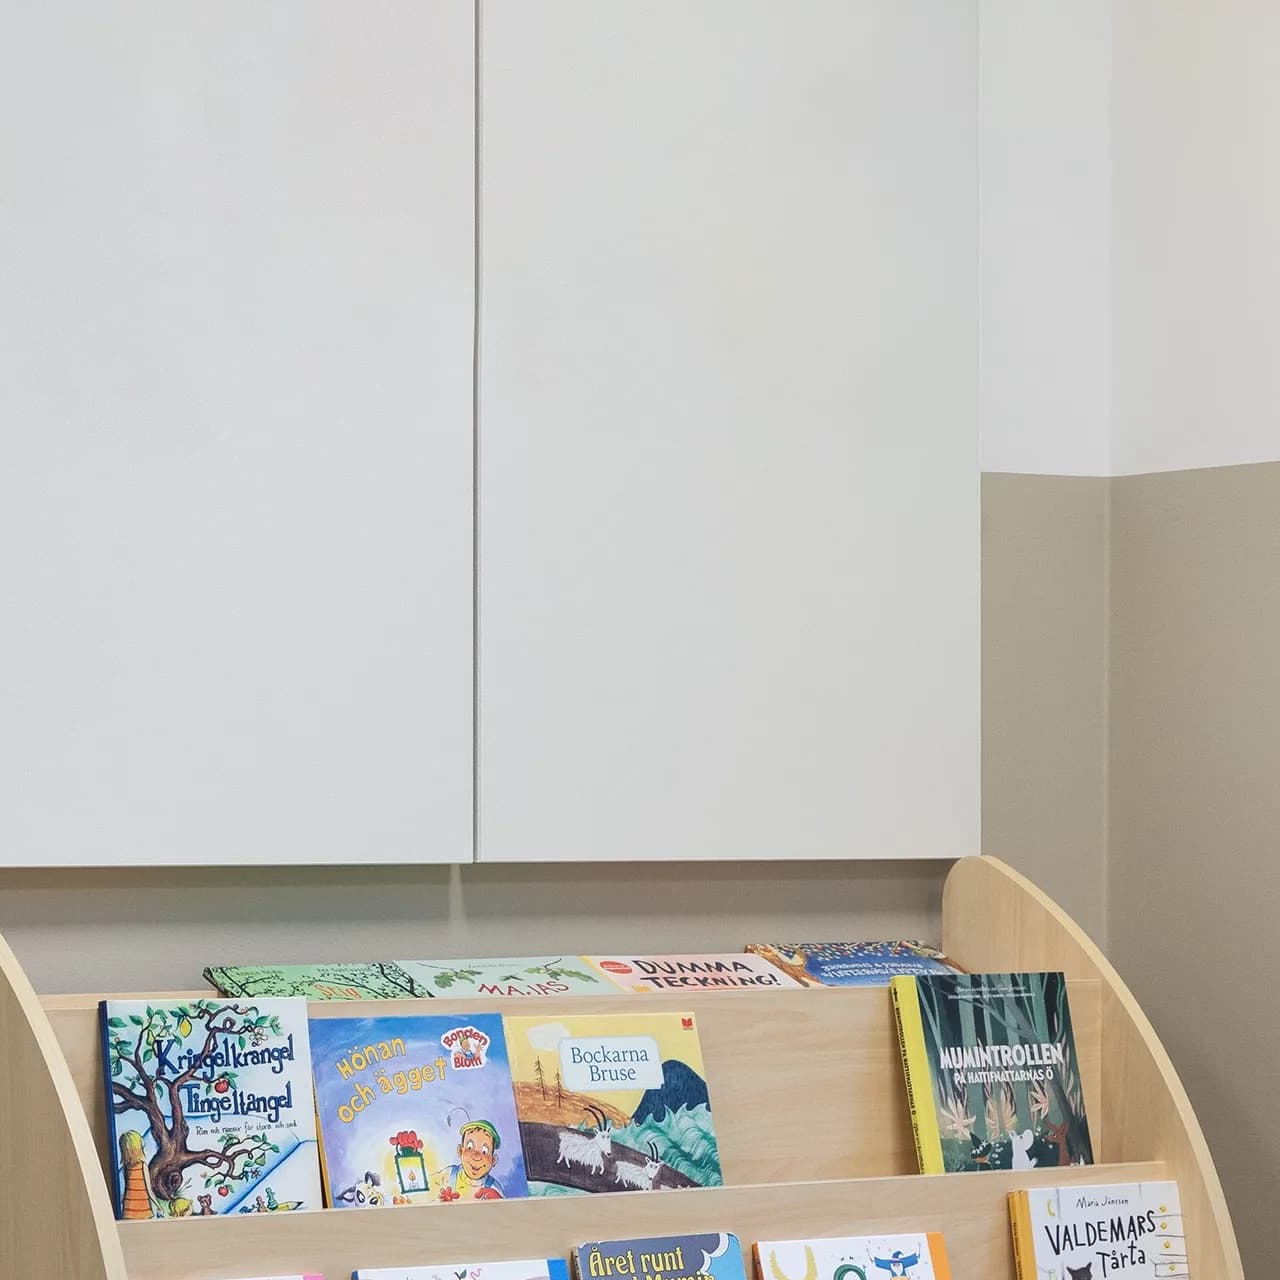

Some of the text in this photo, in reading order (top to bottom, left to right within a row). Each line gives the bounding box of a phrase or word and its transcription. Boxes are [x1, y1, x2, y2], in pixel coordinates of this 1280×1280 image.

[632, 960, 753, 974] DUMMA
[443, 1028, 489, 1048] Bonden
[154, 1034, 295, 1080] Kringelkrangel
[335, 1037, 407, 1080] Hönan
[453, 1055, 482, 1068] Blom
[570, 1045, 649, 1064] Bockarna
[940, 1042, 1064, 1069] MUMINTROLLEN
[589, 1065, 637, 1082] Bruse
[953, 1066, 1054, 1085] PÅ HATTIFNATTARNAS Ö
[177, 1081, 294, 1123] Tingeltangel
[337, 1055, 448, 1123] och ägget
[1076, 1196, 1099, 1208] Maria
[1045, 1210, 1156, 1256] VALDEMARS
[588, 1245, 685, 1277] Året runt
[1096, 1240, 1146, 1278] Tårta
